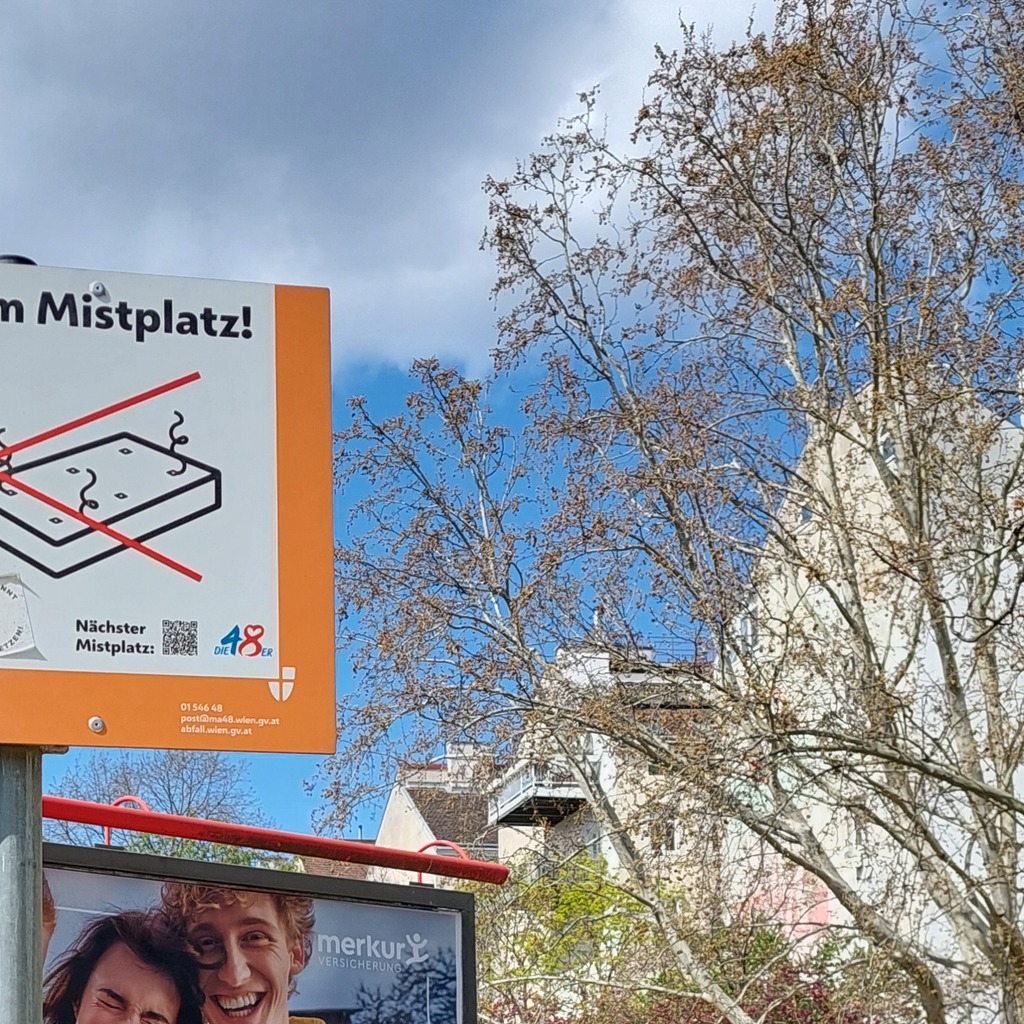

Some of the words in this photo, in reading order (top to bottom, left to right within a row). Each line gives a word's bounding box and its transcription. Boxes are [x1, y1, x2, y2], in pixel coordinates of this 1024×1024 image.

[37, 291, 253, 343] Mistplatz!
[76, 619, 147, 635] Nächster
[76, 639, 155, 657] Mistplatz:
[180, 703, 191, 711] 01
[192, 703, 210, 712] 546
[211, 704, 223, 712] 48
[180, 714, 280, 727] post@ma48.wien.gv.at
[180, 725, 253, 737] abfall.wien.gv.at
[317, 934, 406, 960] merkur
[318, 956, 402, 973] VERSICHERUNG
